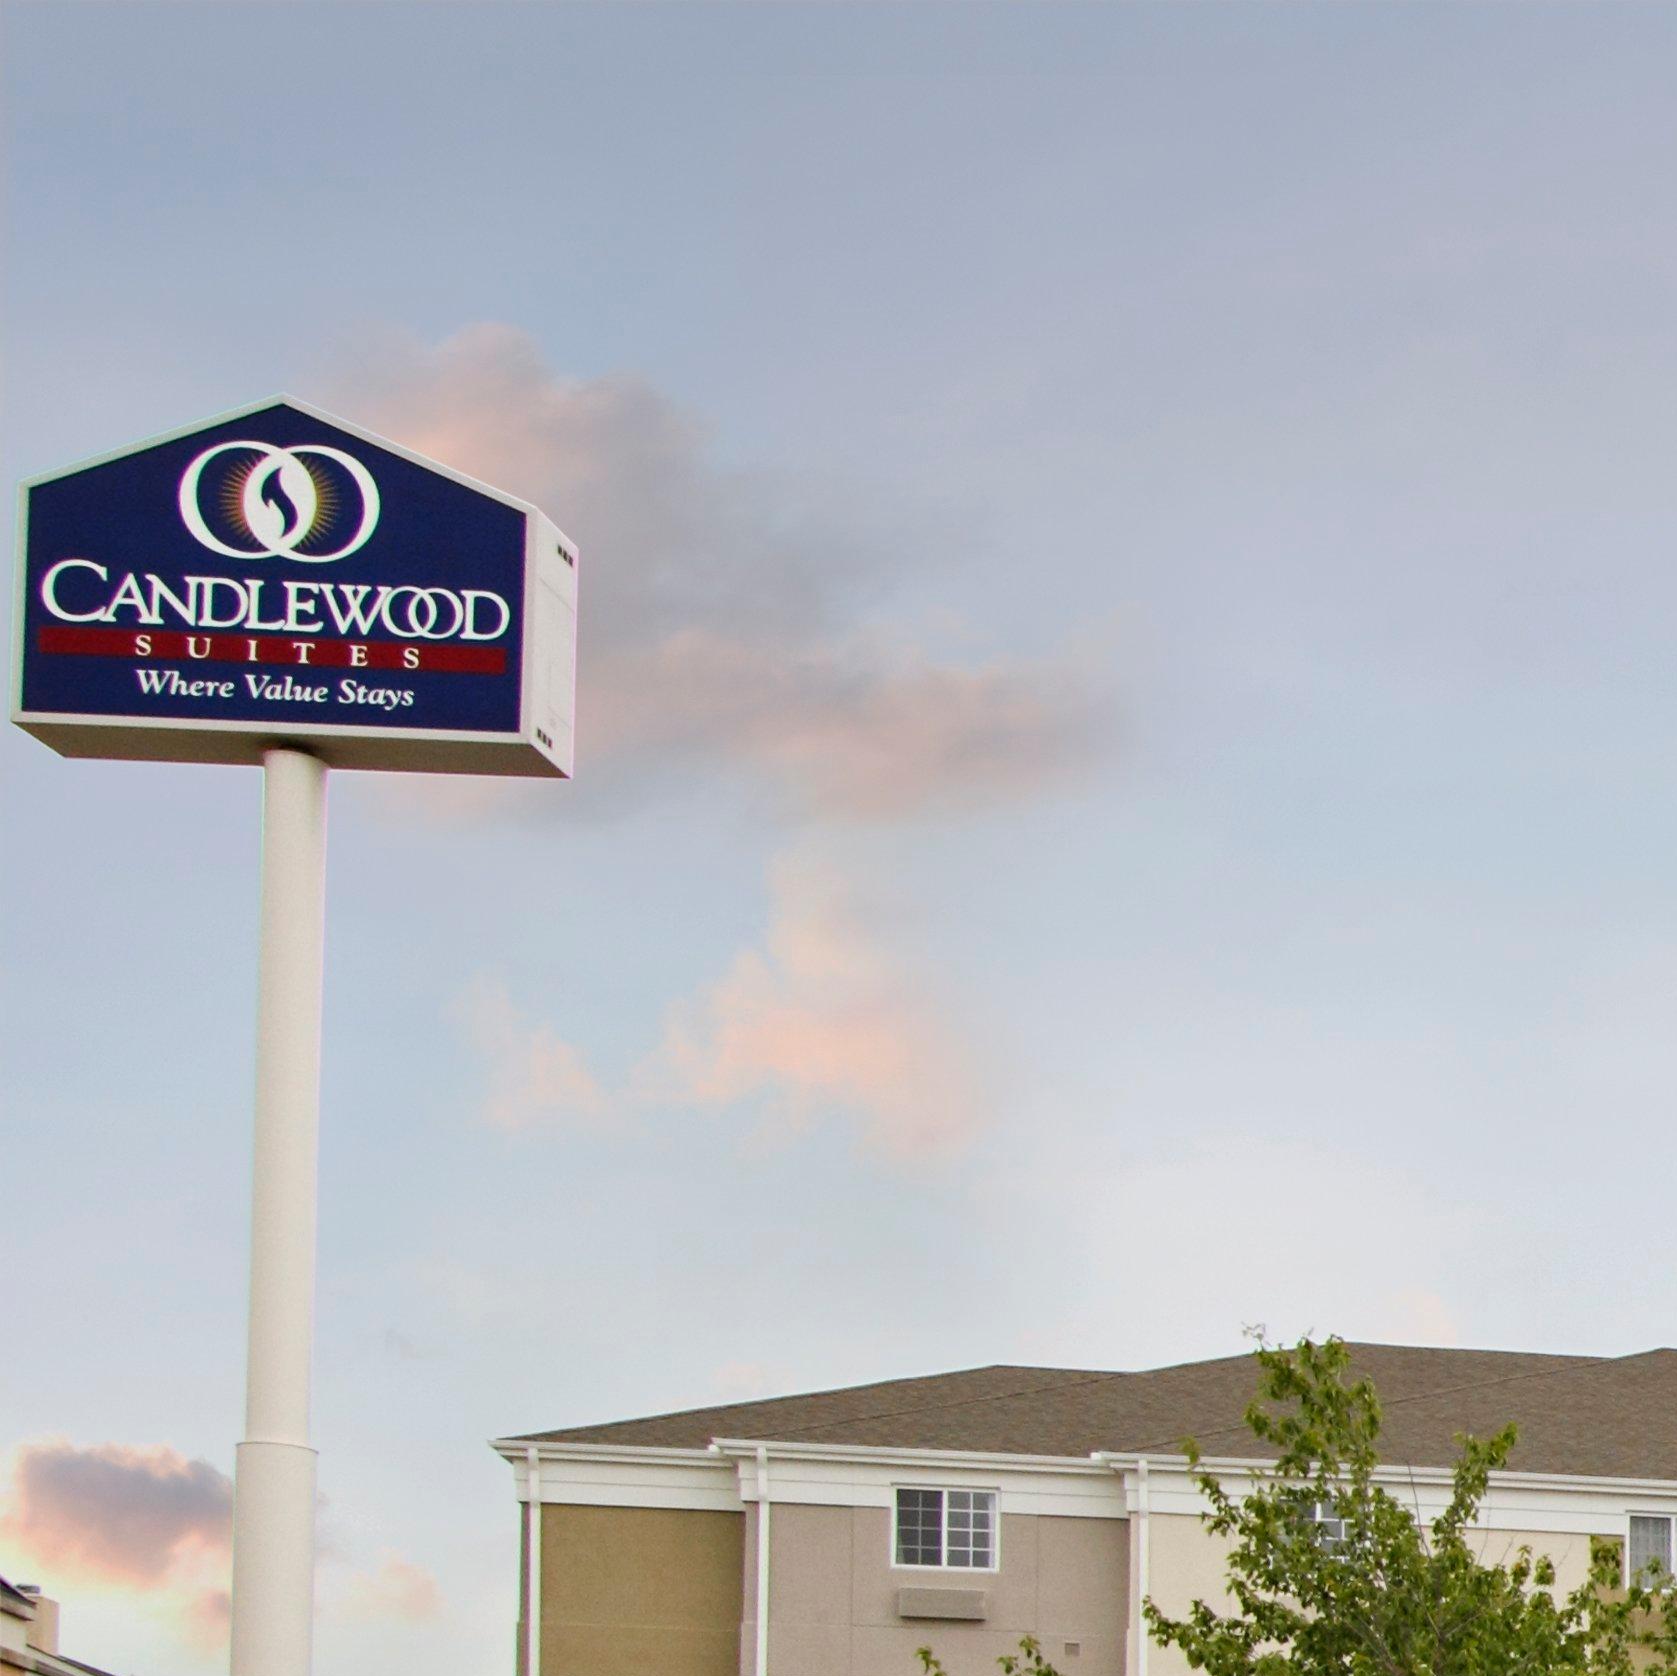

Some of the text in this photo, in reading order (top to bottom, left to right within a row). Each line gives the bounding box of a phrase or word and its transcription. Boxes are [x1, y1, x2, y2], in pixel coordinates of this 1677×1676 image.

[40, 558, 511, 641] CANDLEWOOD
[134, 635, 421, 669] SUITES
[137, 669, 415, 711] Where Value Stays
